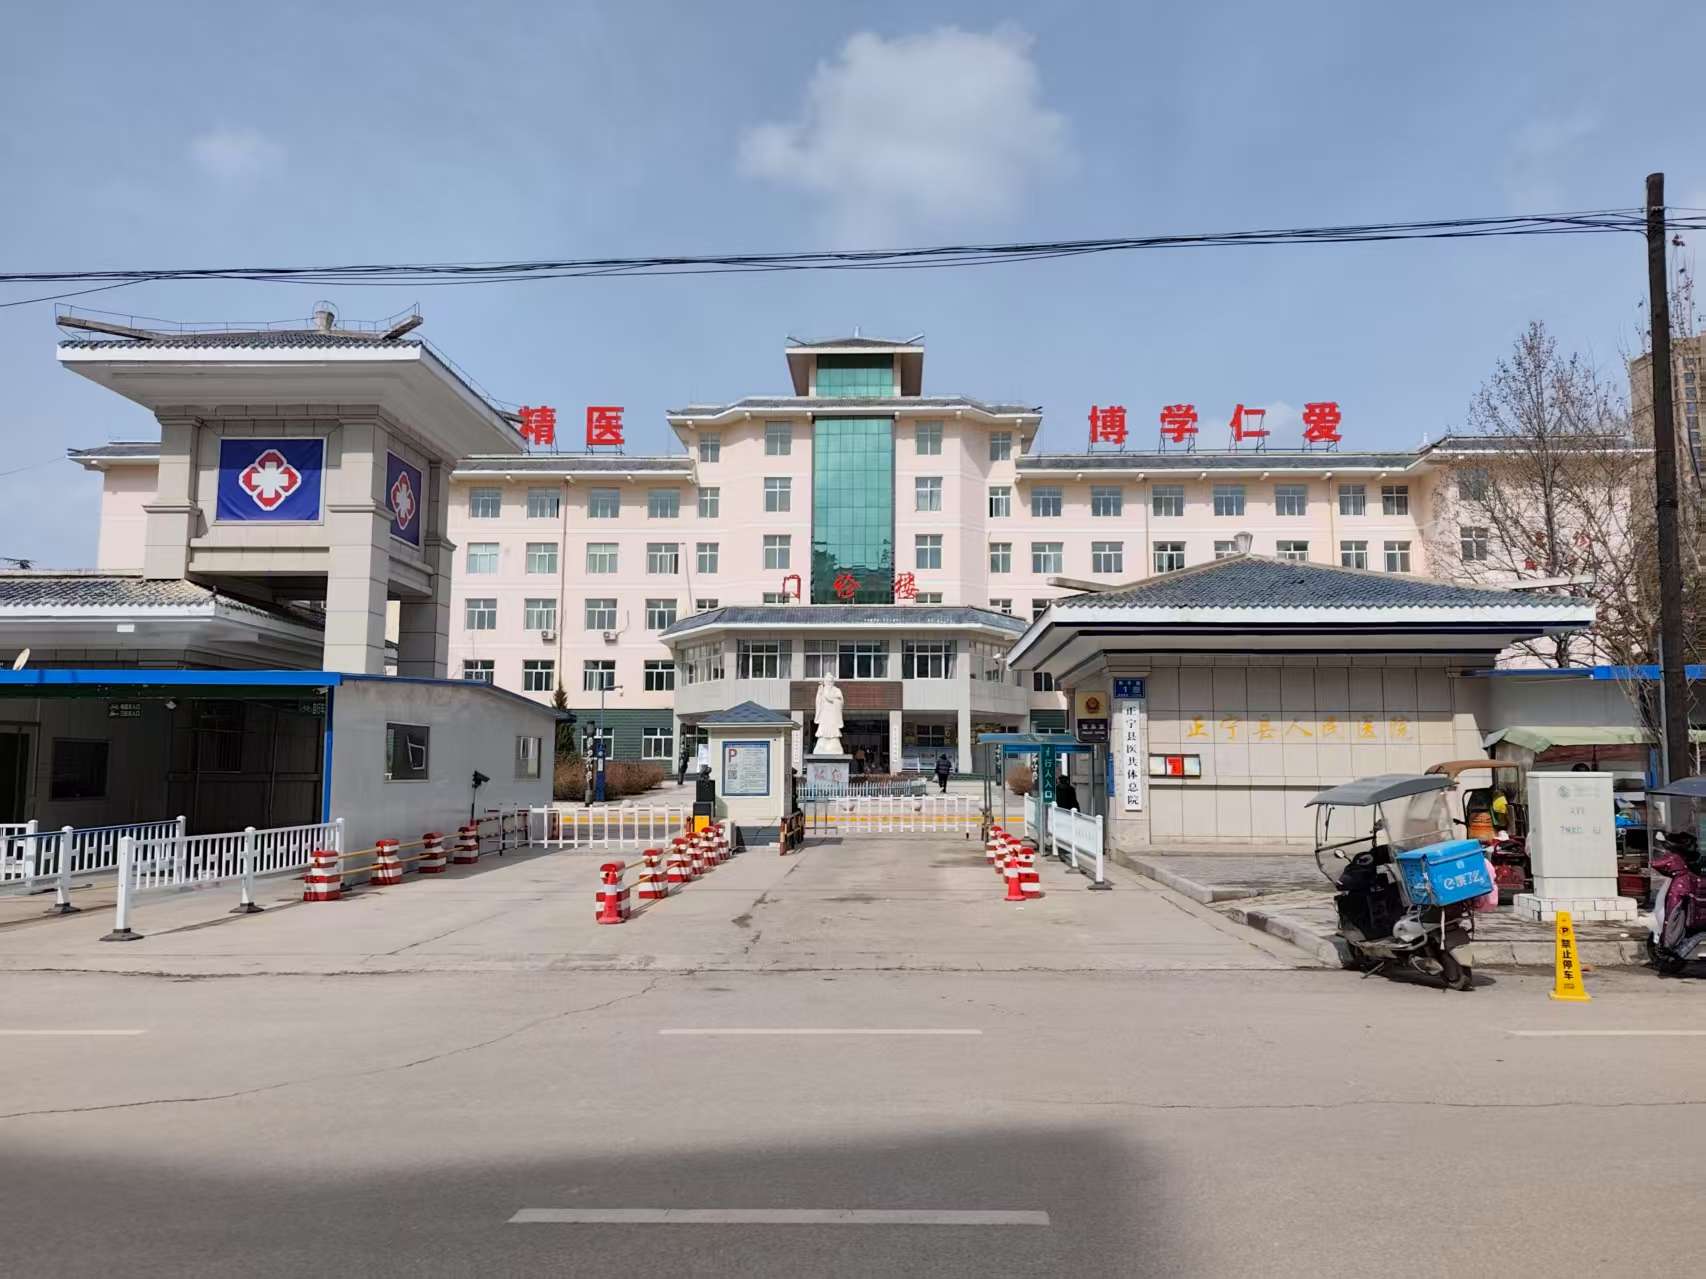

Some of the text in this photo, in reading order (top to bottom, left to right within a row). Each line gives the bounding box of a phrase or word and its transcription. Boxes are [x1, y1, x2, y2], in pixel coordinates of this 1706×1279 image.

[518, 405, 625, 446] 精医
[1088, 401, 1343, 445] 博学仁爱
[1186, 713, 1414, 741] 正宁县人民医院
[1125, 705, 1140, 806] 正宁县医共体总院
[1561, 939, 1575, 980] 禁止停车
